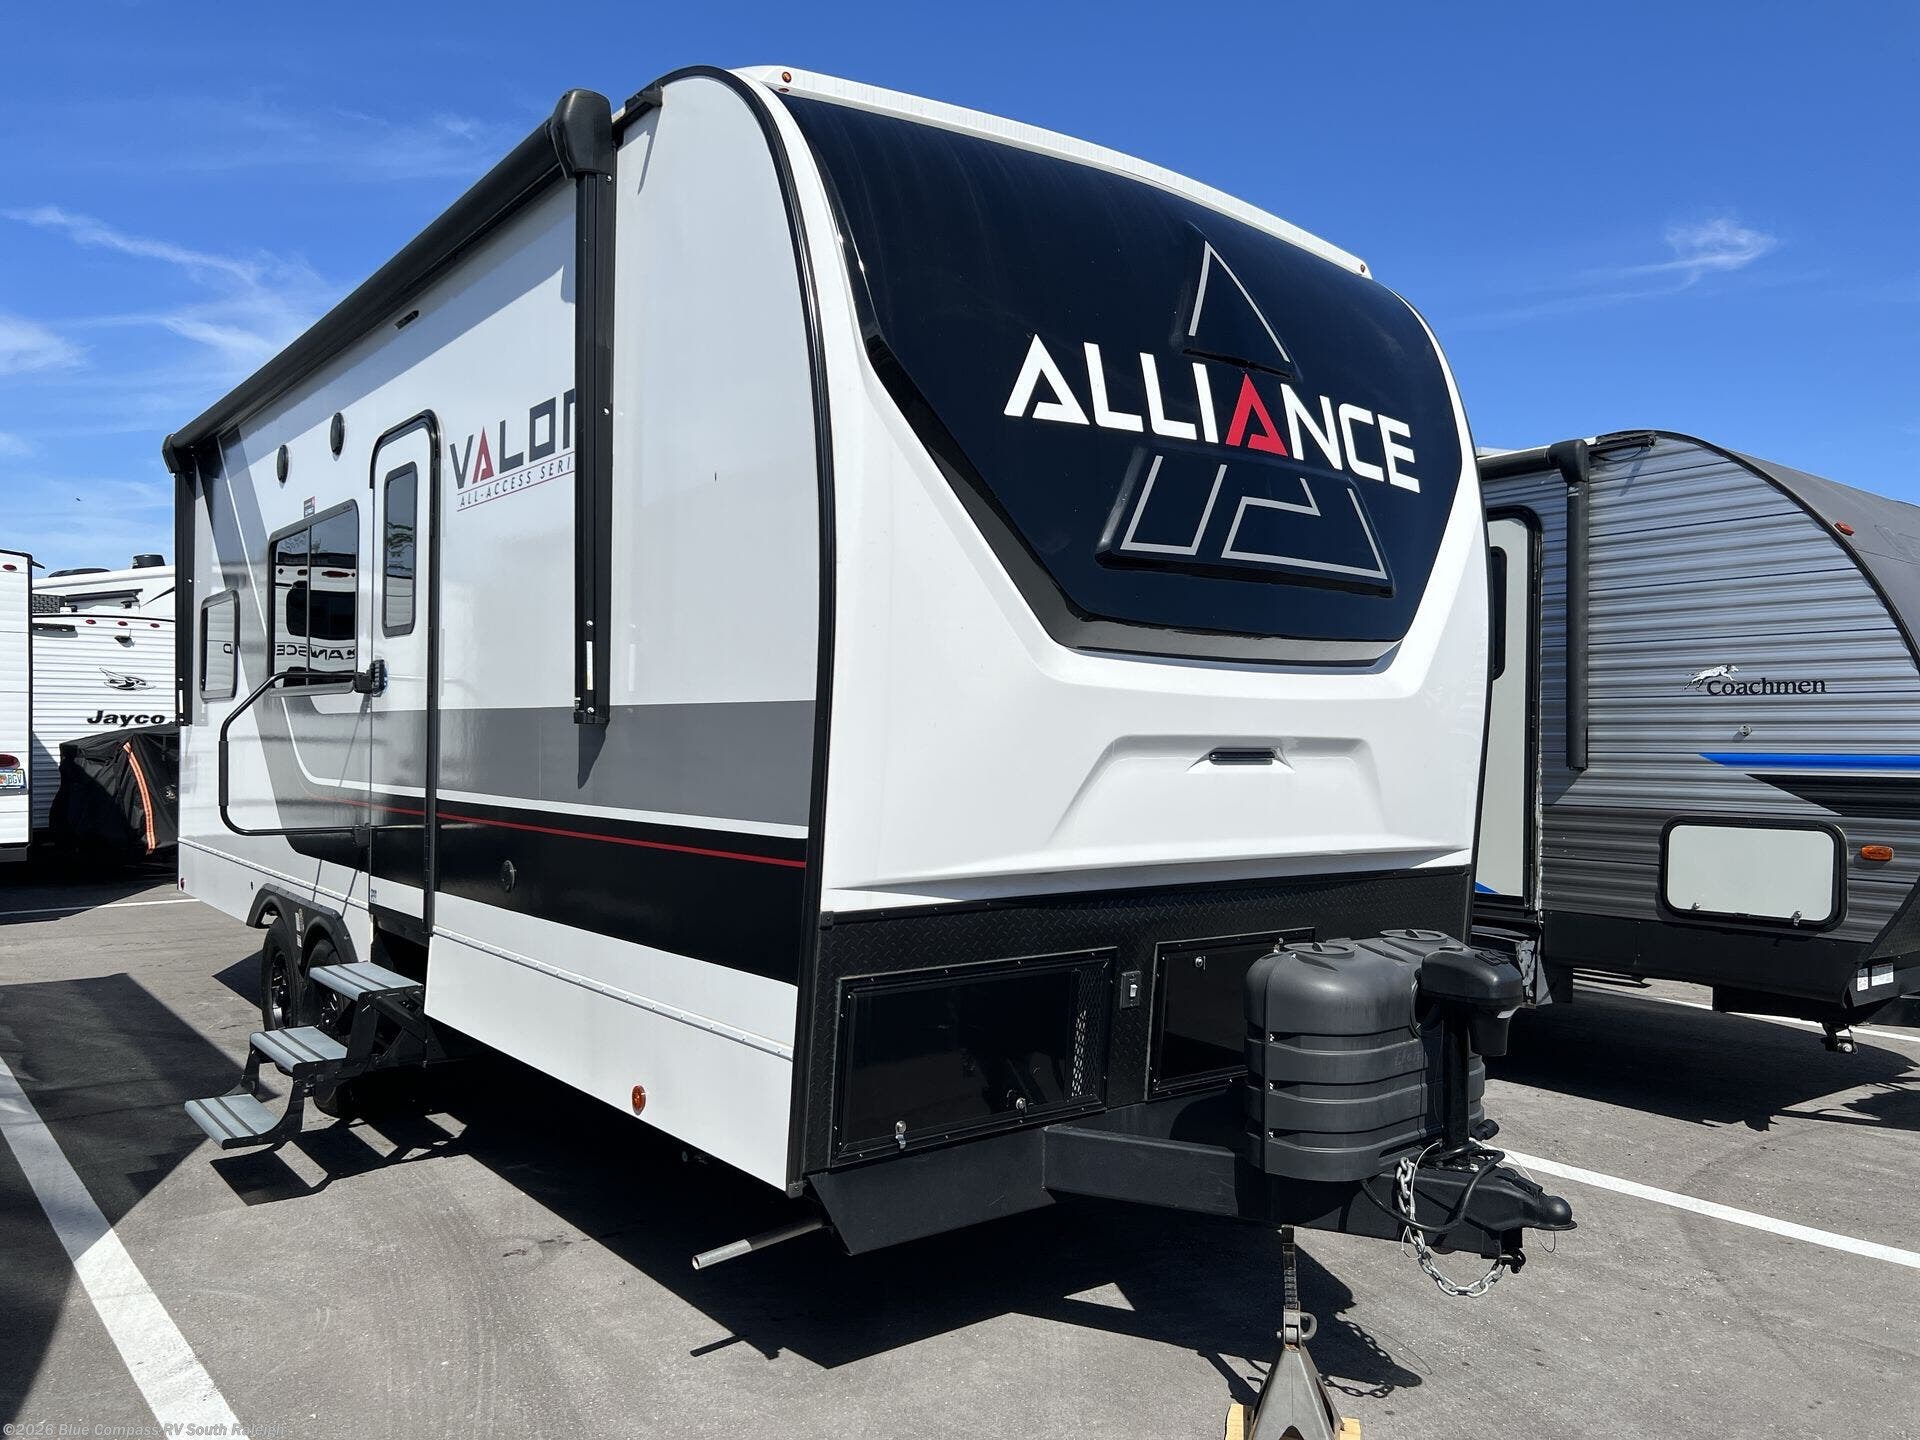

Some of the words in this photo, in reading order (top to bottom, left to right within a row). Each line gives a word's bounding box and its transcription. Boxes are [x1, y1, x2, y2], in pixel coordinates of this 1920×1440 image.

[1003, 333, 1421, 494] ALLIANCE
[459, 470, 532, 508] ALL-ACCESS
[1706, 677, 1827, 696] Coachmen
[87, 710, 166, 728] Jayco
